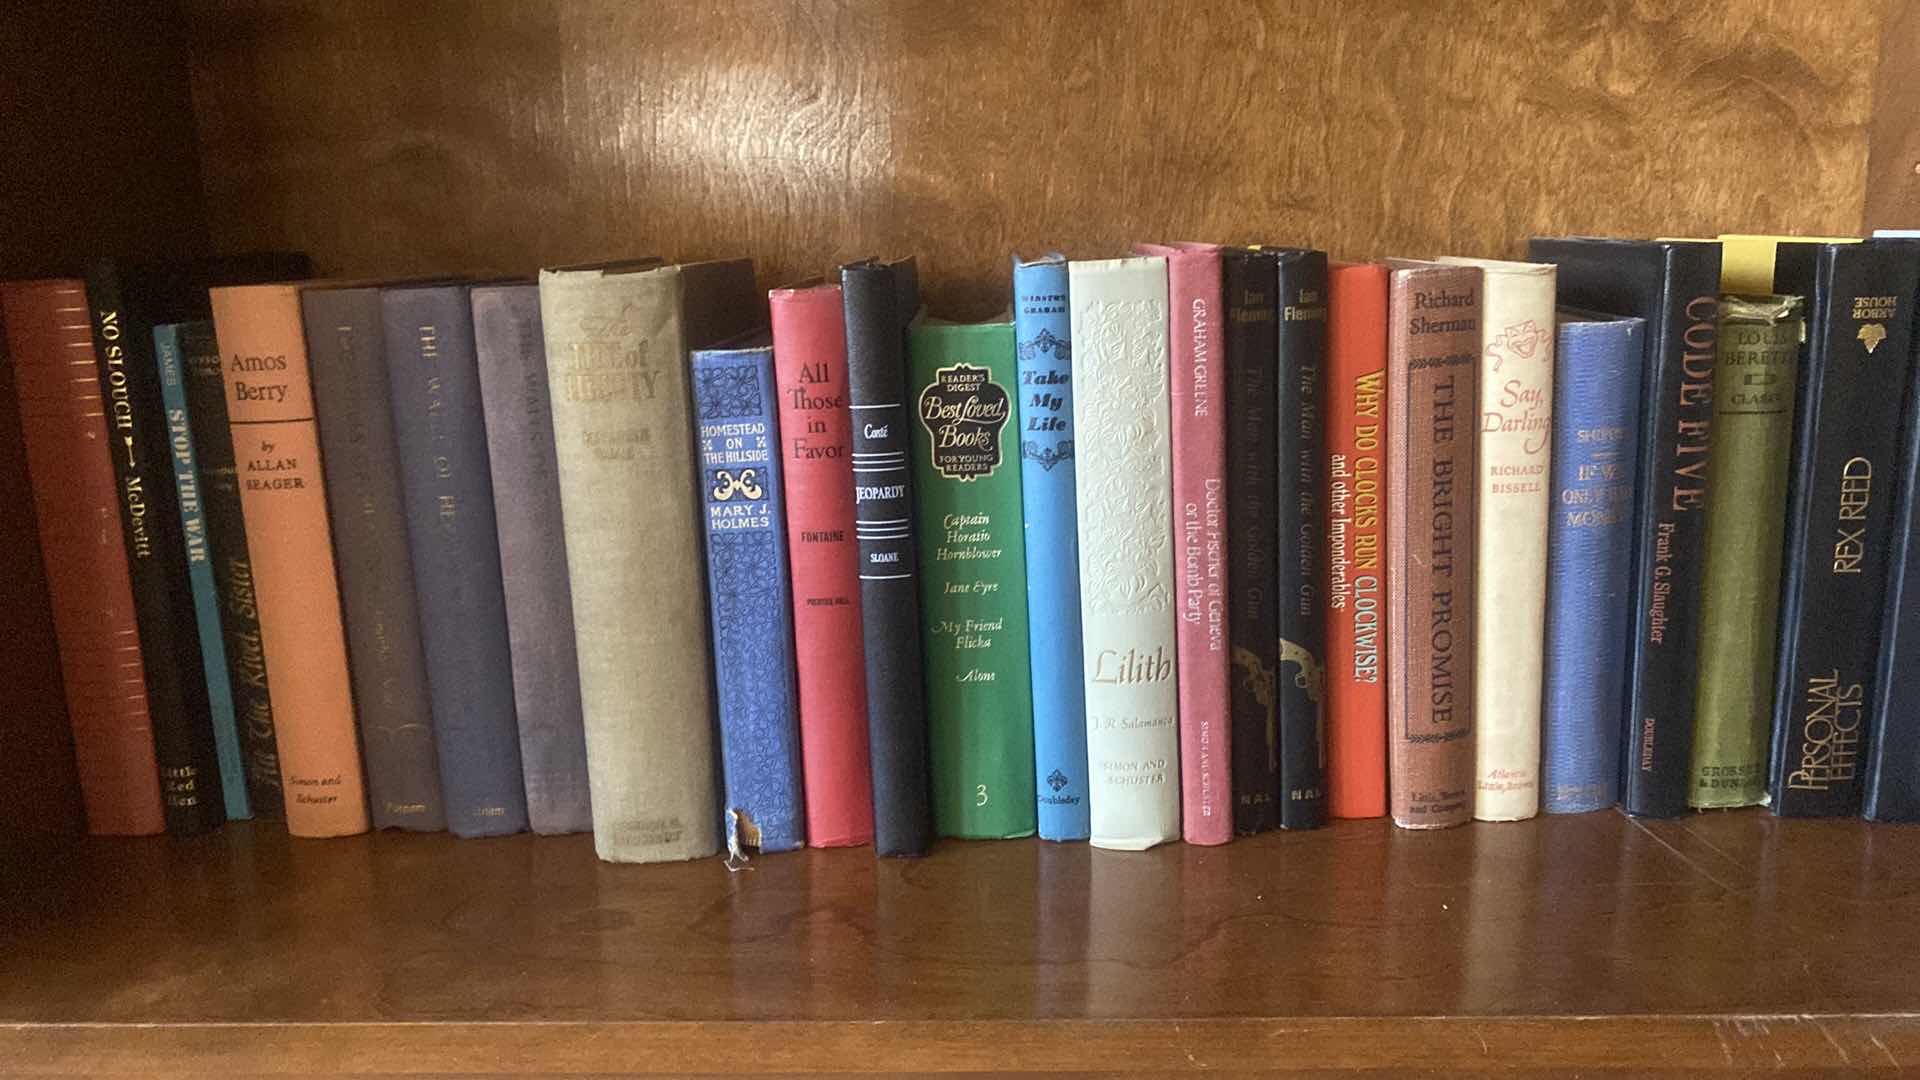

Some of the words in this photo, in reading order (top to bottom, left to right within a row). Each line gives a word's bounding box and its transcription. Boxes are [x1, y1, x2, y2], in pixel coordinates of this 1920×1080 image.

[1023, 306, 1066, 314] GRAHAM
[1415, 289, 1474, 309] Richard
[1854, 296, 1897, 307] HOUSE
[1852, 307, 1896, 318] ARBOR
[100, 311, 118, 340] NO
[1192, 298, 1207, 362] GRAHAM
[1409, 317, 1476, 336] Sherman
[231, 353, 287, 372] Amos
[1680, 296, 1716, 406] CODE
[799, 362, 830, 384] All
[1023, 371, 1069, 385] Take
[1301, 365, 1315, 396] The
[105, 345, 133, 429] SLOUCH
[235, 380, 287, 403] Berry
[786, 386, 842, 411] Those
[947, 383, 981, 392] DIGEST
[1193, 364, 1208, 417] GREENE
[1355, 368, 1386, 418] WHY
[1501, 379, 1543, 407] Say,
[923, 396, 962, 420] Best
[953, 395, 1006, 425] Loved
[1029, 393, 1064, 411] My
[1433, 376, 1454, 442] THE
[701, 424, 764, 438] HOMESTEAD
[807, 419, 827, 434] in
[1027, 417, 1067, 432] Life
[1301, 401, 1315, 439] Man
[168, 408, 190, 465] STOP
[726, 438, 743, 449] ON
[938, 424, 993, 452] Books
[1355, 425, 1379, 451] DO
[1482, 412, 1551, 455] Darling
[261, 441, 274, 453] by
[704, 451, 724, 464] THE
[725, 450, 768, 463] HILLSIDE
[793, 438, 843, 460] Favor
[940, 455, 958, 464] FOR
[959, 453, 994, 463] YOUNG
[247, 458, 297, 472] ALLAN
[946, 463, 989, 472] READERS
[1301, 447, 1315, 485] with
[1332, 455, 1352, 478] and
[1490, 465, 1543, 476] RICHARD
[1673, 420, 1713, 512] FIVE
[177, 468, 199, 514] THE
[246, 477, 304, 491] SEAGER
[855, 485, 905, 504] JEOPARDY
[1355, 455, 1377, 529] CLOCKS
[1492, 482, 1542, 493] BISSELL
[1839, 456, 1872, 521] REED
[1186, 503, 1197, 515] or
[1204, 479, 1221, 528] Doctor
[1301, 492, 1315, 513] the
[1332, 482, 1352, 515] other
[125, 476, 152, 558] McDevitt
[711, 504, 753, 518] MARY
[759, 504, 771, 515] J.
[711, 516, 769, 529] HOLMES
[943, 512, 990, 530] Captain
[1432, 458, 1454, 577] BRIGHT
[187, 517, 207, 561] WAR
[801, 530, 846, 543] FONTAINE
[946, 529, 991, 544] Horatio
[1185, 520, 1201, 544] the
[1655, 522, 1678, 563] Frank
[869, 552, 900, 563] SLOANE
[936, 547, 1001, 561] Hornblower
[1206, 532, 1222, 582] Fischer
[1300, 523, 1315, 576] Golden
[1354, 534, 1377, 569] RUN
[1834, 528, 1867, 574] REX
[1186, 546, 1202, 588] Bomb
[1331, 518, 1352, 610] Imponderables
[1655, 565, 1672, 581] G.
[944, 582, 970, 595] Jane
[973, 580, 1000, 596] Eyre
[1207, 584, 1222, 597] of
[1182, 589, 1202, 625] Party
[1300, 584, 1314, 616] Gun
[1650, 581, 1672, 646] Slaughter
[931, 620, 961, 637] My
[965, 617, 1003, 633] Friend
[1207, 600, 1223, 651] Geneva
[1354, 575, 1377, 684] CLOCKWISE?
[956, 635, 992, 650] Flicka
[1092, 646, 1172, 685] Lilith
[1432, 591, 1455, 725] PROMISE
[956, 669, 996, 682] Alone
[1788, 668, 1839, 791] PERSONAL
[1832, 684, 1864, 781] EFFECTS
[1641, 718, 1656, 771] DOUBLEDAY
[1103, 761, 1138, 772] SIMON
[1140, 759, 1166, 770] AND
[290, 775, 318, 787] Simon
[320, 775, 342, 787] and
[1104, 773, 1166, 786] SCHUSTER
[295, 792, 338, 806] Schuster
[976, 784, 988, 807] 3
